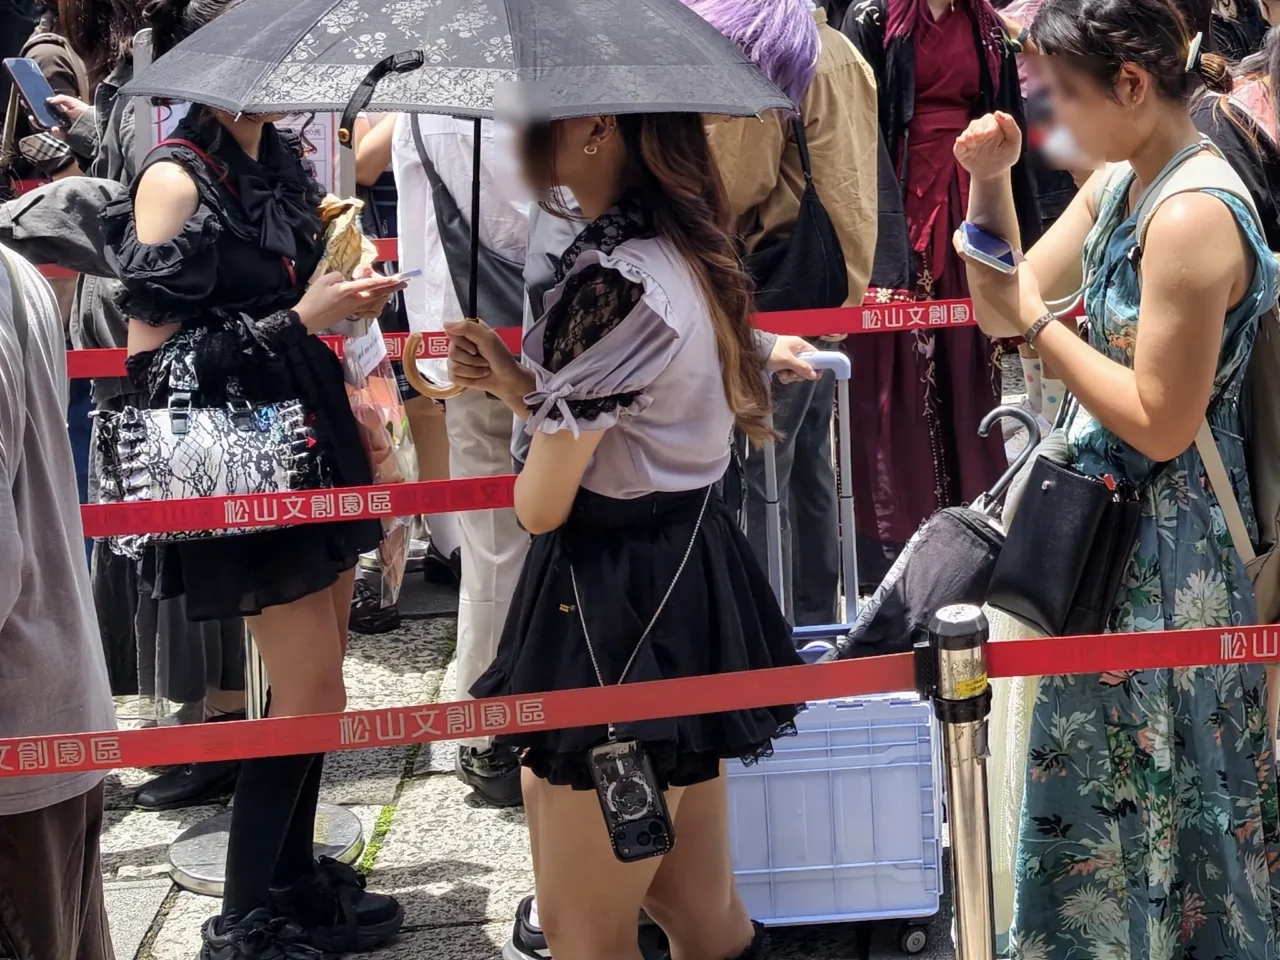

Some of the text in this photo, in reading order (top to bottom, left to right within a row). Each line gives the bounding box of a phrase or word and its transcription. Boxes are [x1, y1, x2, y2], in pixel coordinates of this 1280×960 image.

[862, 304, 977, 330] 松山文創園
[224, 491, 393, 523] 松山文創園區
[339, 697, 546, 745] 松山文創園區
